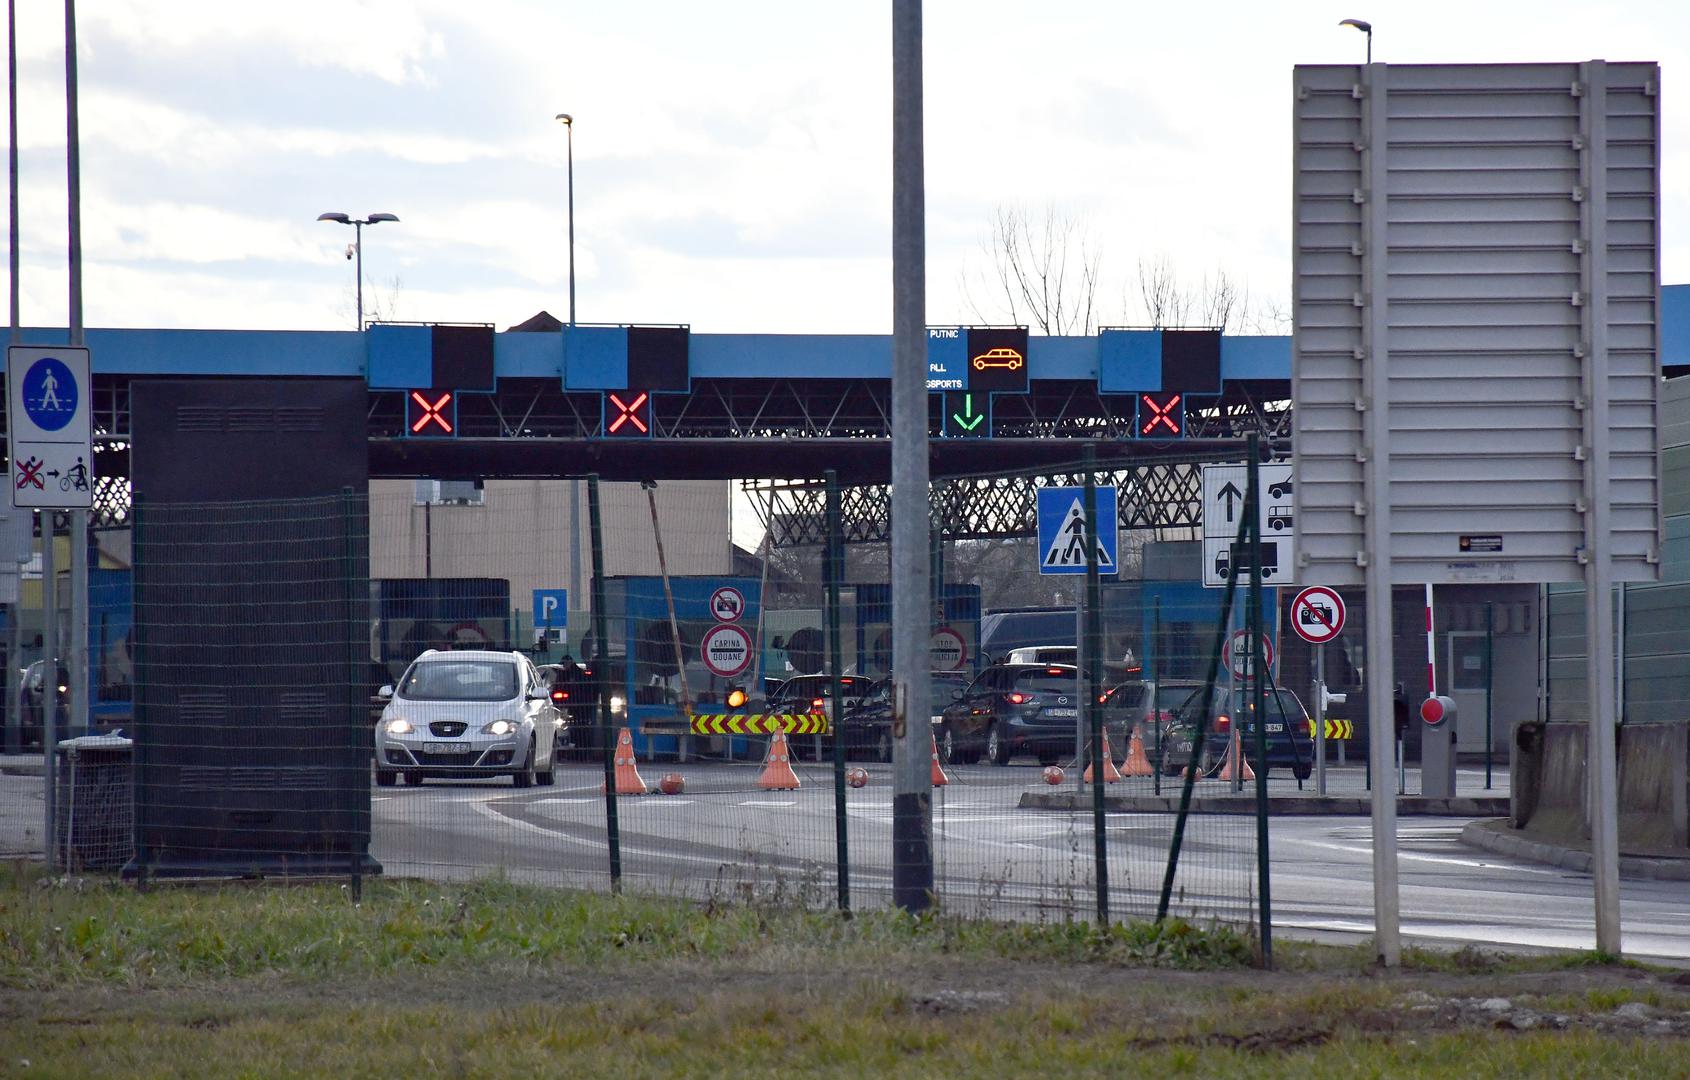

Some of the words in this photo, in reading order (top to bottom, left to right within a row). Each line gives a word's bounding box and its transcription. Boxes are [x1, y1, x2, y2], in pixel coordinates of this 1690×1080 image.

[930, 363, 947, 372] ALL
[542, 596, 558, 620] P
[714, 639, 741, 648] CARINA
[713, 652, 742, 661] DOUANE
